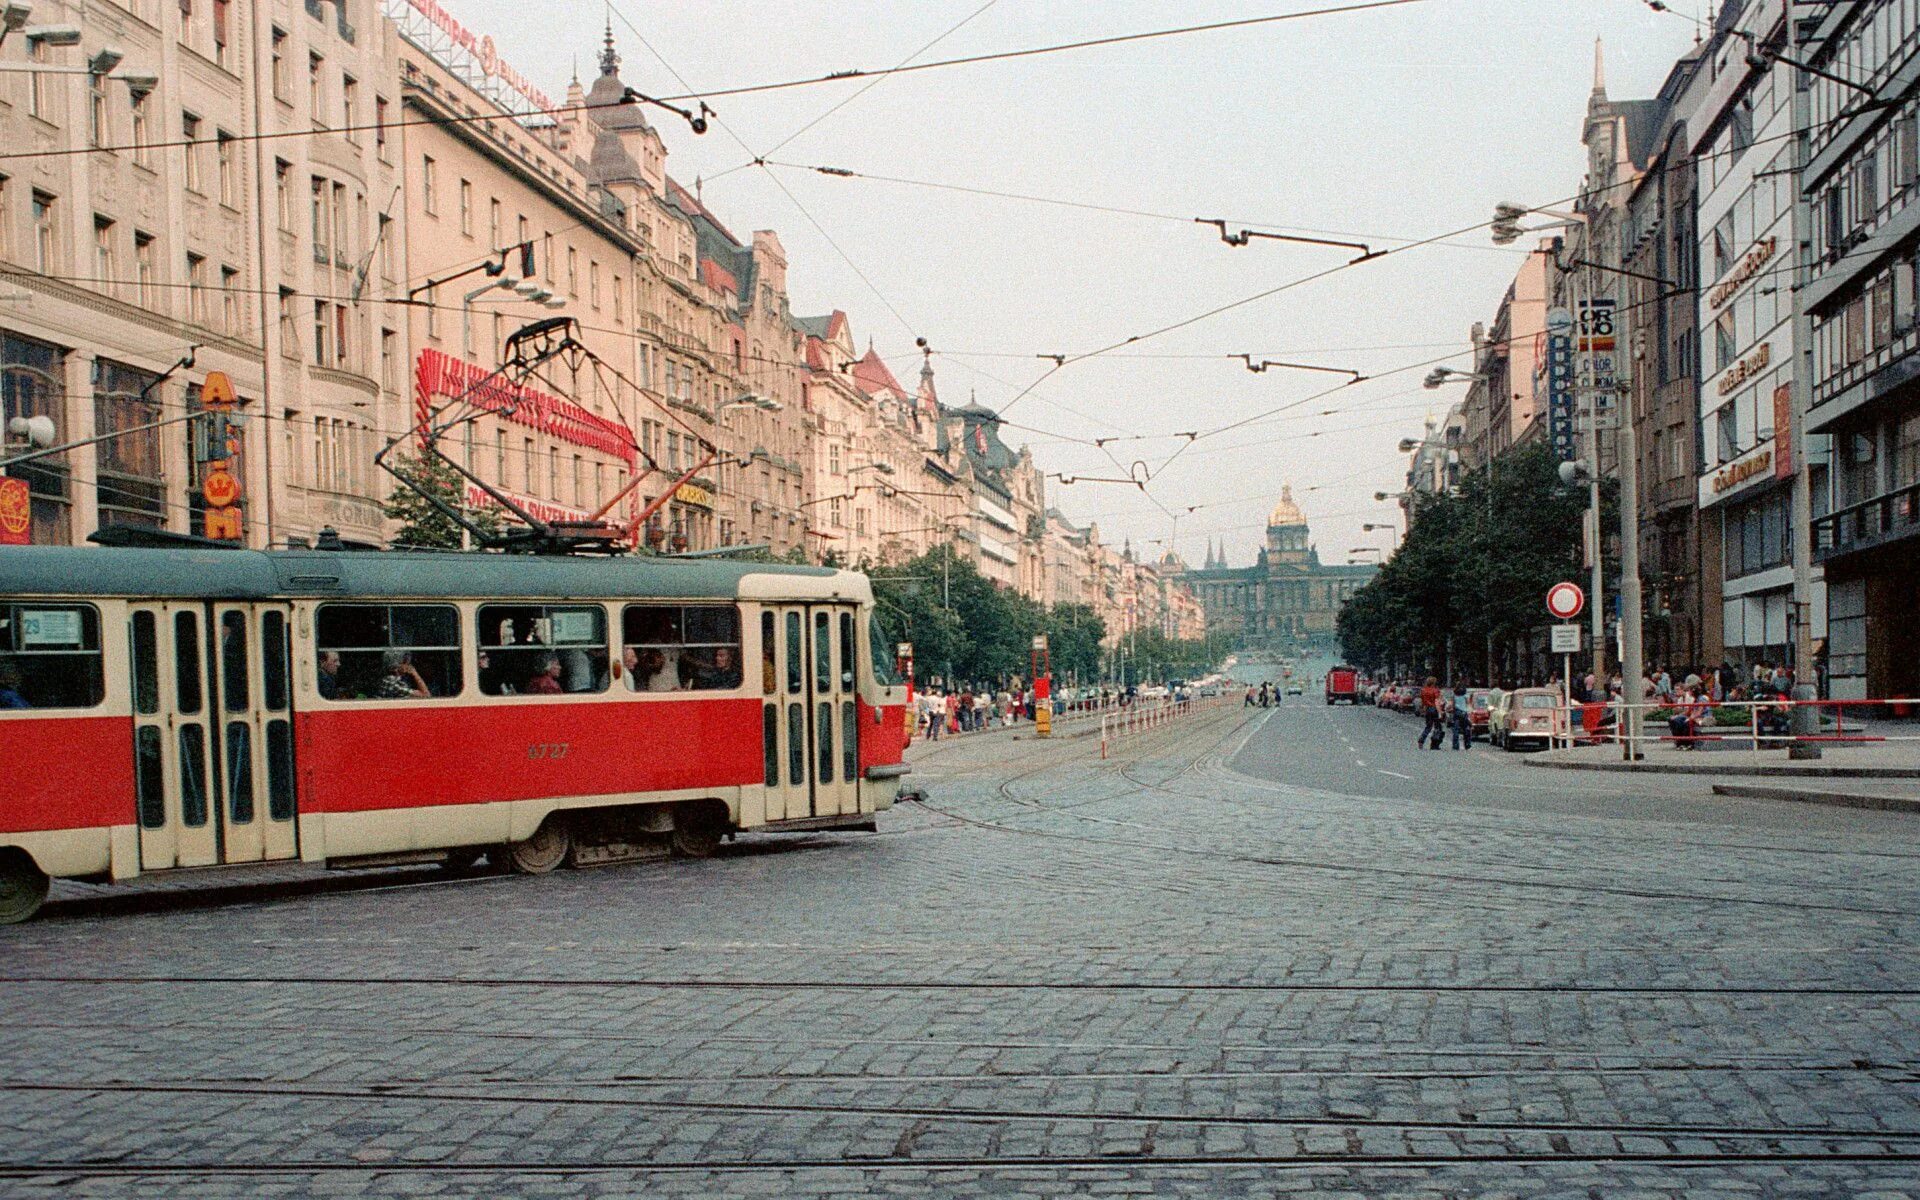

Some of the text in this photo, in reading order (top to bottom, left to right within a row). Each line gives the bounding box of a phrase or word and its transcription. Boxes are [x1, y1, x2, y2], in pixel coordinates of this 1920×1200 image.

[1580, 309, 1612, 322] OR
[1581, 322, 1613, 336] WO
[1583, 358, 1611, 372] CLOR
